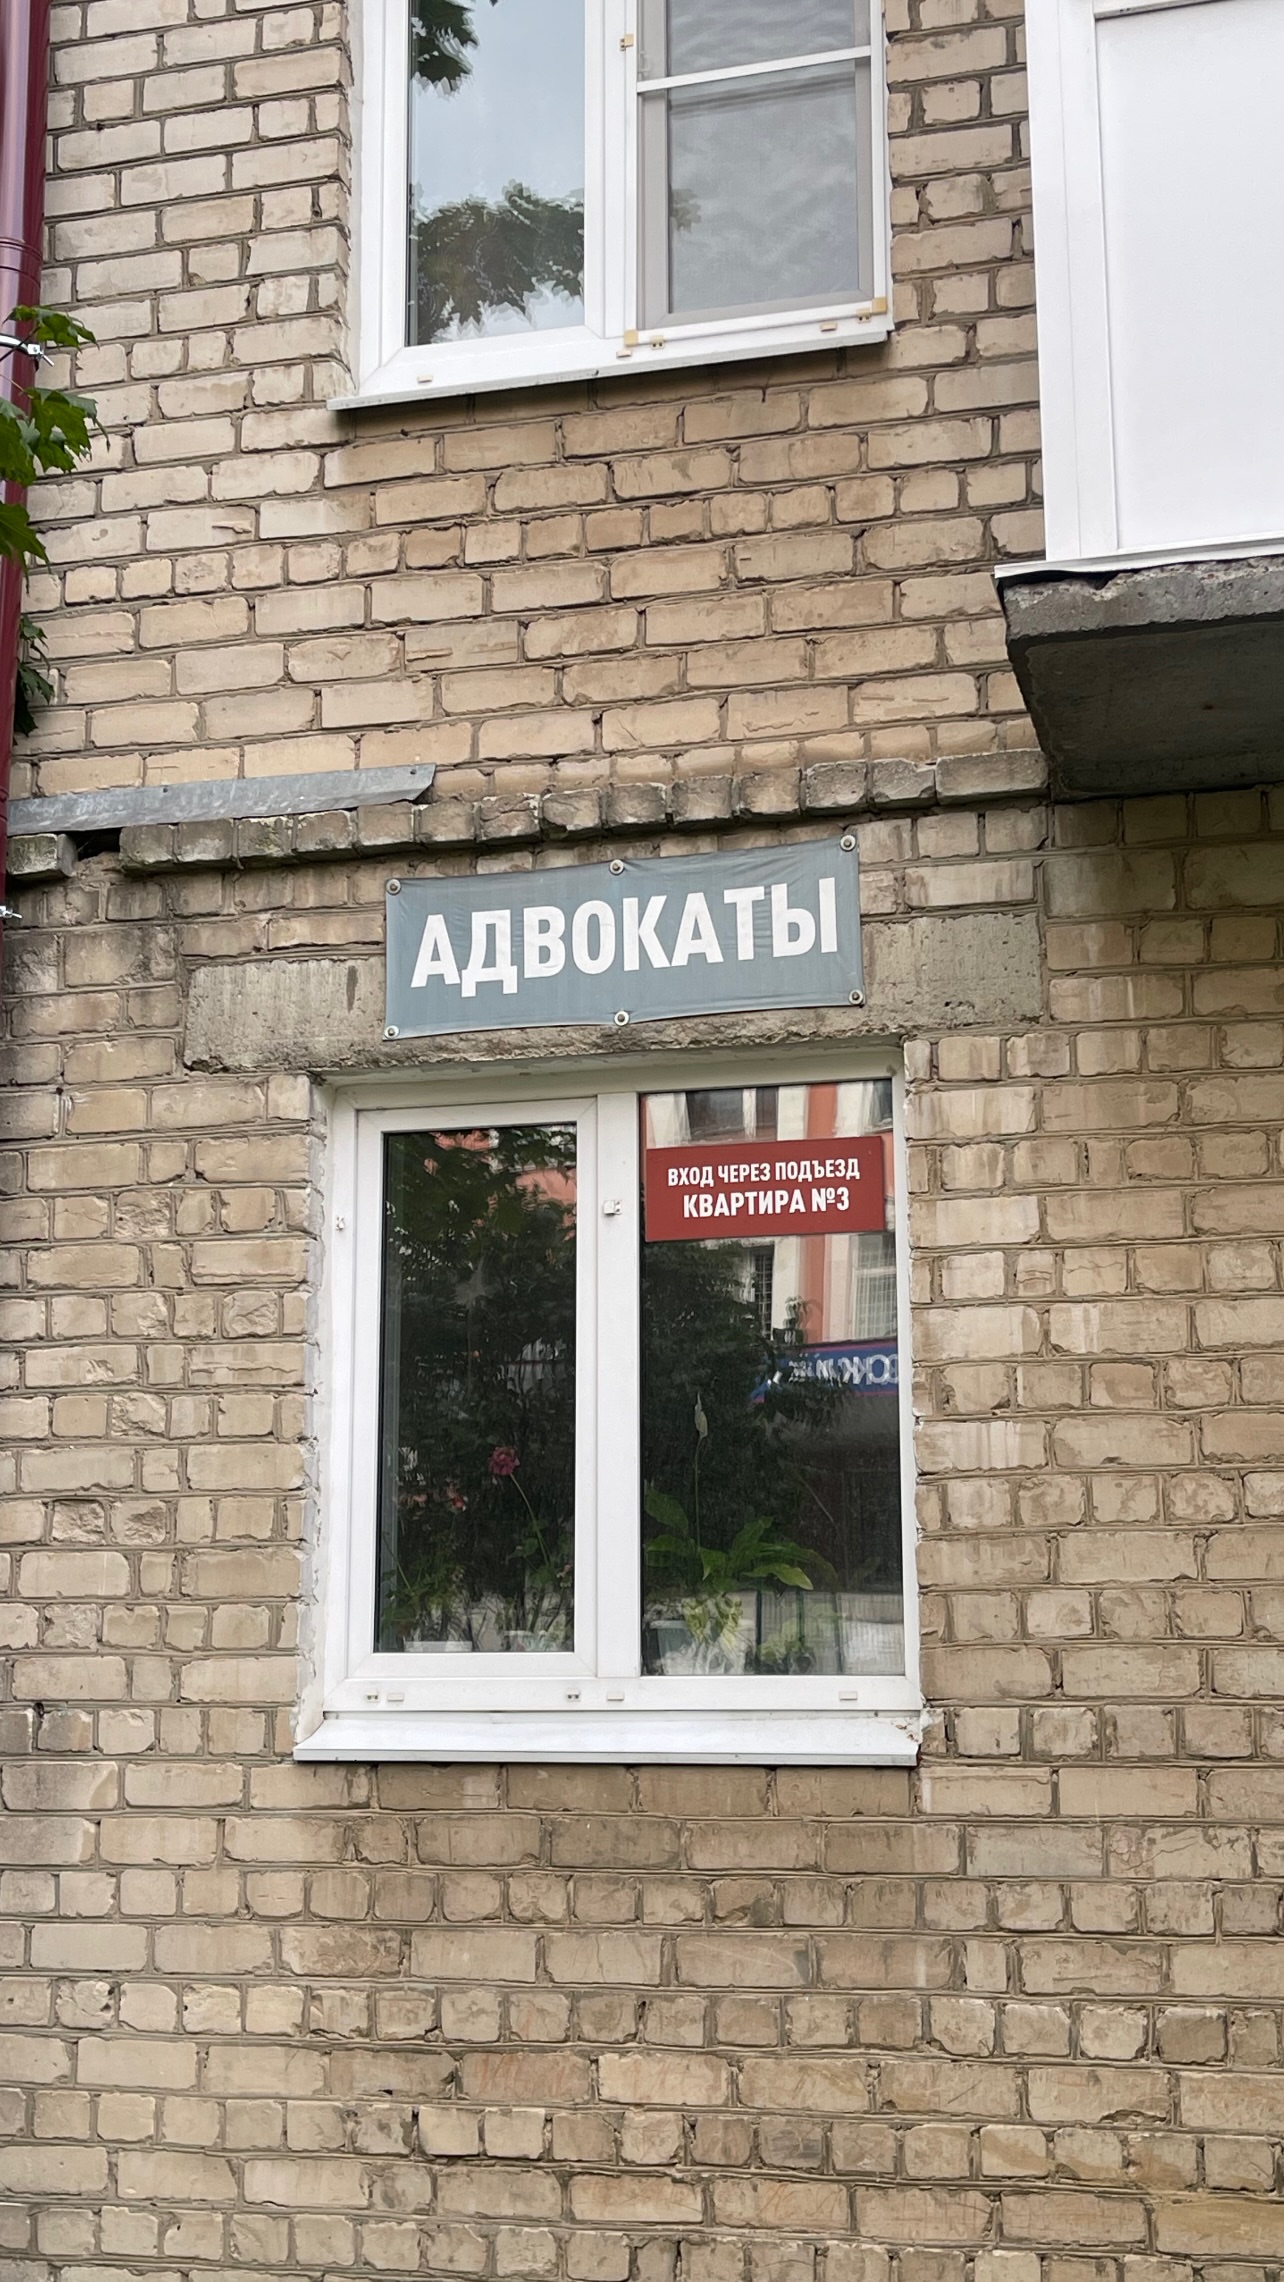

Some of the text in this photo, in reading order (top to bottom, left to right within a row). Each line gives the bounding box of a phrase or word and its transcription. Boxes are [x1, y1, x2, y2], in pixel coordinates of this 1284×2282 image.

[410, 877, 838, 998] АДВОКАТЫ
[667, 1158, 860, 1188] ВХОД ЧЕРЕЗ ПОДЪЕЗД
[683, 1187, 850, 1218] КВАРТИРА №3
